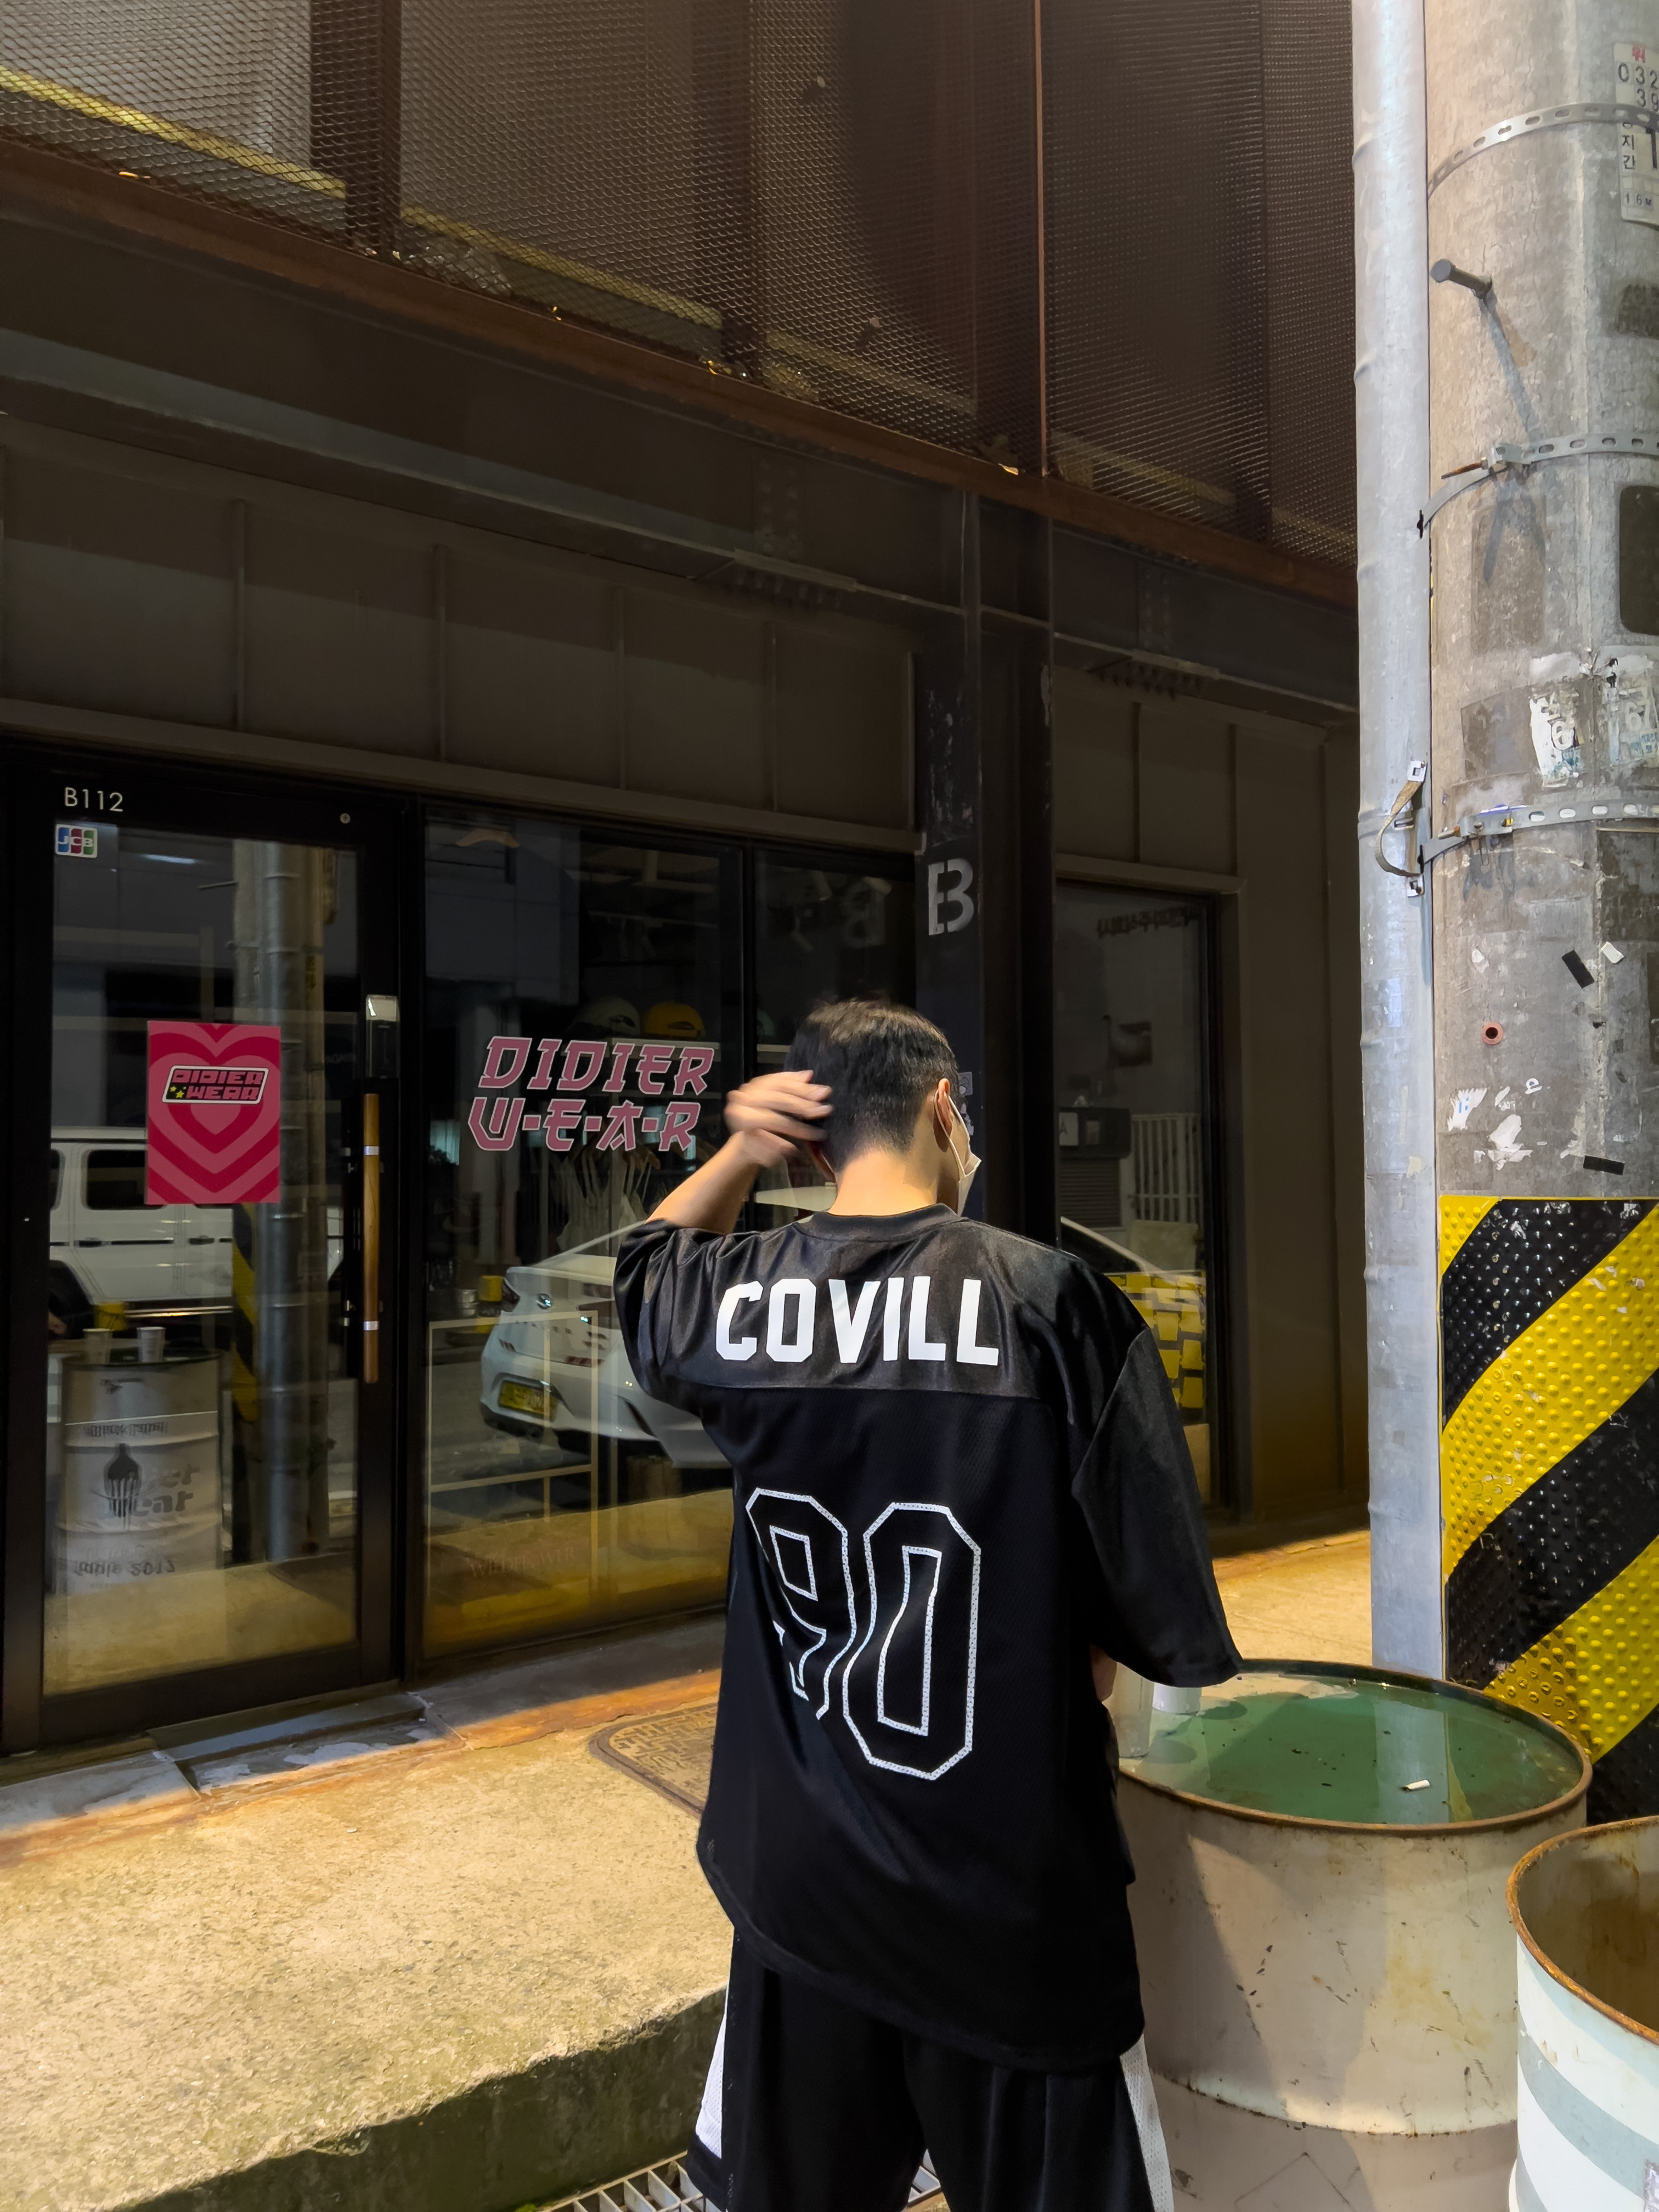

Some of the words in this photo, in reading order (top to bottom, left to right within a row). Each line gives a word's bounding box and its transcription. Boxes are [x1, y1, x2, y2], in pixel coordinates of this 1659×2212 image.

[65, 787, 123, 812] B112
[58, 836, 93, 848] JCB
[928, 858, 974, 936] B
[172, 1070, 264, 1085] DIDIER
[478, 1036, 715, 1096] DIDIER
[185, 1085, 260, 1100] WEAR
[715, 1276, 1000, 1366] COVILL
[746, 1487, 981, 1781] 90
